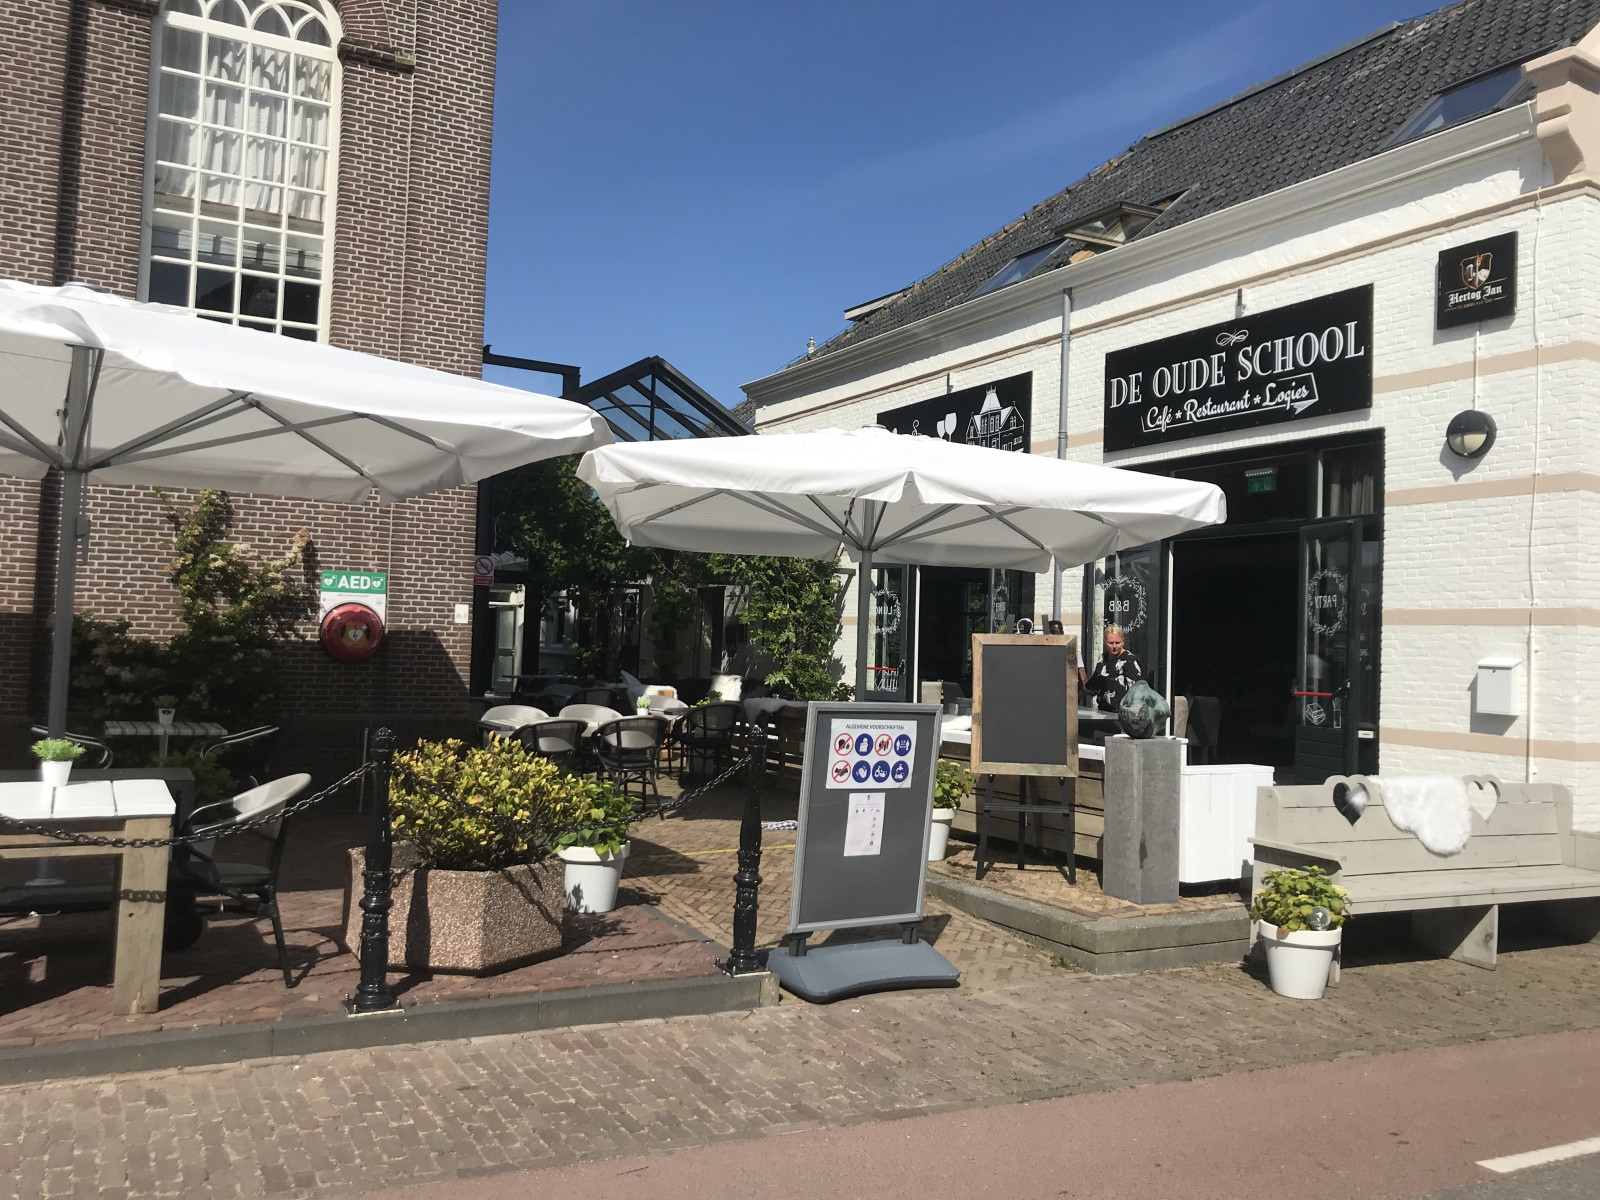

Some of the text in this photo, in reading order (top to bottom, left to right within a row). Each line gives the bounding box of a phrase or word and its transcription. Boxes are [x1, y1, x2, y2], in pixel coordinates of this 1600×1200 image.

[1448, 290, 1482, 307] Hertog
[1483, 284, 1503, 299] Jan
[1110, 320, 1365, 409] DE OUDE SCHOOL
[1147, 380, 1310, 433] Café Restaurant Logies
[337, 575, 371, 590] AED
